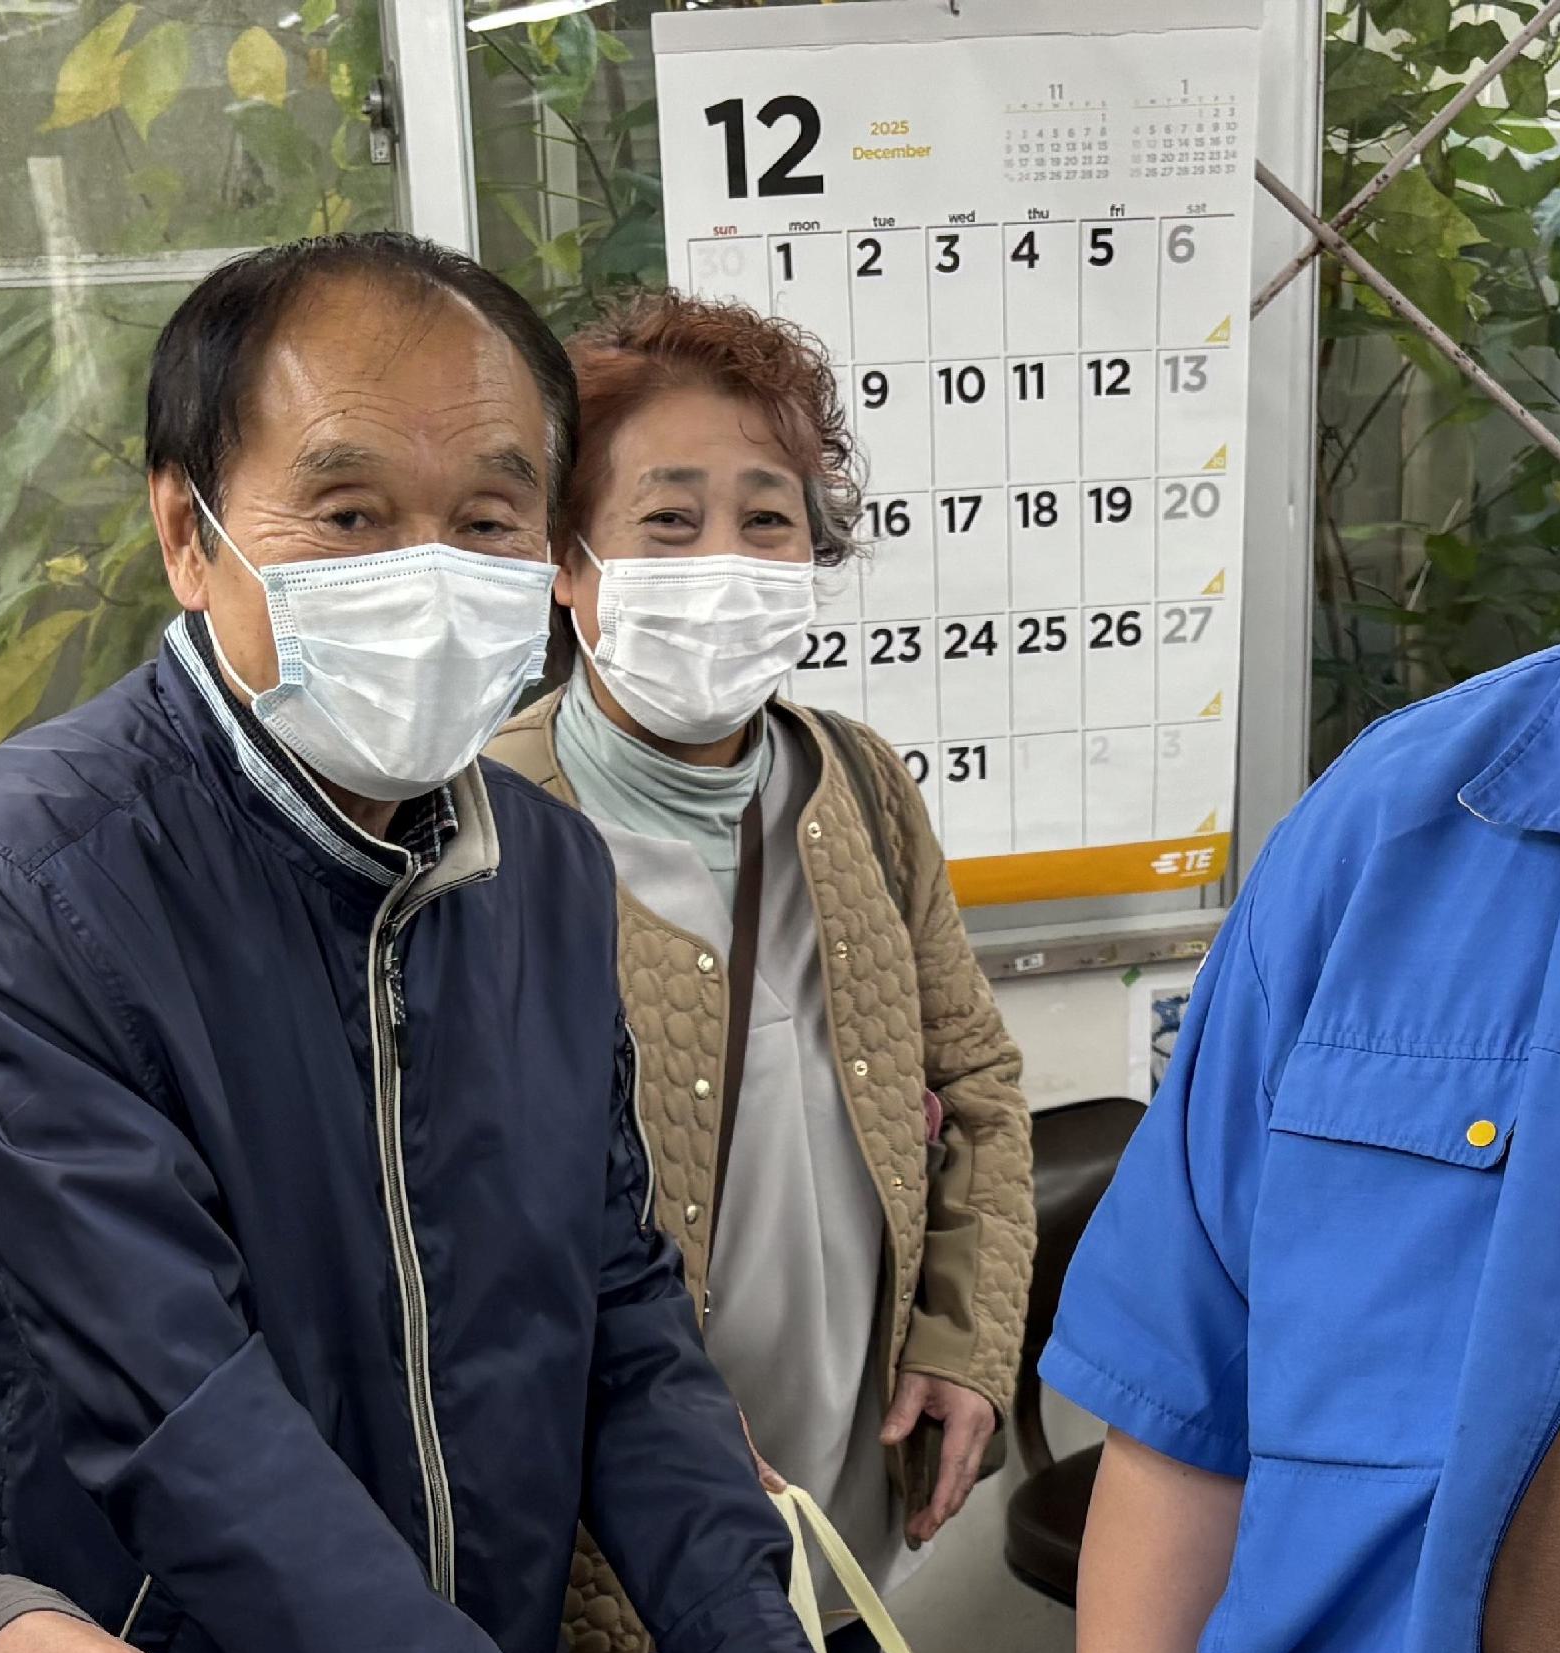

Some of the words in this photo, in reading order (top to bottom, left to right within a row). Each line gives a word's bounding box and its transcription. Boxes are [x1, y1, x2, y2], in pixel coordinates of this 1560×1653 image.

[1049, 84, 1063, 100] 11
[705, 94, 824, 199] 12
[852, 143, 932, 160] December
[871, 121, 909, 136] 2025
[713, 225, 737, 237] sun
[788, 220, 820, 232] mon
[873, 216, 895, 228] tue
[948, 210, 976, 223] wed
[1027, 208, 1050, 220] thu
[1109, 204, 1126, 217] fri
[1186, 203, 1207, 215] sat
[696, 246, 746, 280] 30
[775, 243, 793, 280] 1
[856, 239, 882, 276] 2
[936, 235, 960, 273] 3
[1011, 232, 1039, 268] 4
[1088, 229, 1114, 266] 5
[1167, 225, 1195, 264] 6
[861, 371, 888, 409] 9
[938, 365, 985, 404] 10
[1013, 362, 1044, 399] 11
[1087, 359, 1131, 396] 12
[1164, 354, 1208, 394] 13
[866, 500, 910, 537] 16
[941, 496, 982, 533] 17
[1016, 491, 1058, 528] 18
[1088, 487, 1133, 524] 19
[1164, 483, 1220, 520] 20
[797, 631, 847, 669] 22
[870, 627, 921, 664] 23
[944, 621, 997, 659] 24
[1017, 617, 1067, 654] 25
[1089, 612, 1142, 649] 26
[1163, 606, 1213, 644] 27
[904, 750, 929, 784] 0
[948, 745, 986, 782] 31
[1163, 730, 1181, 758] 3
